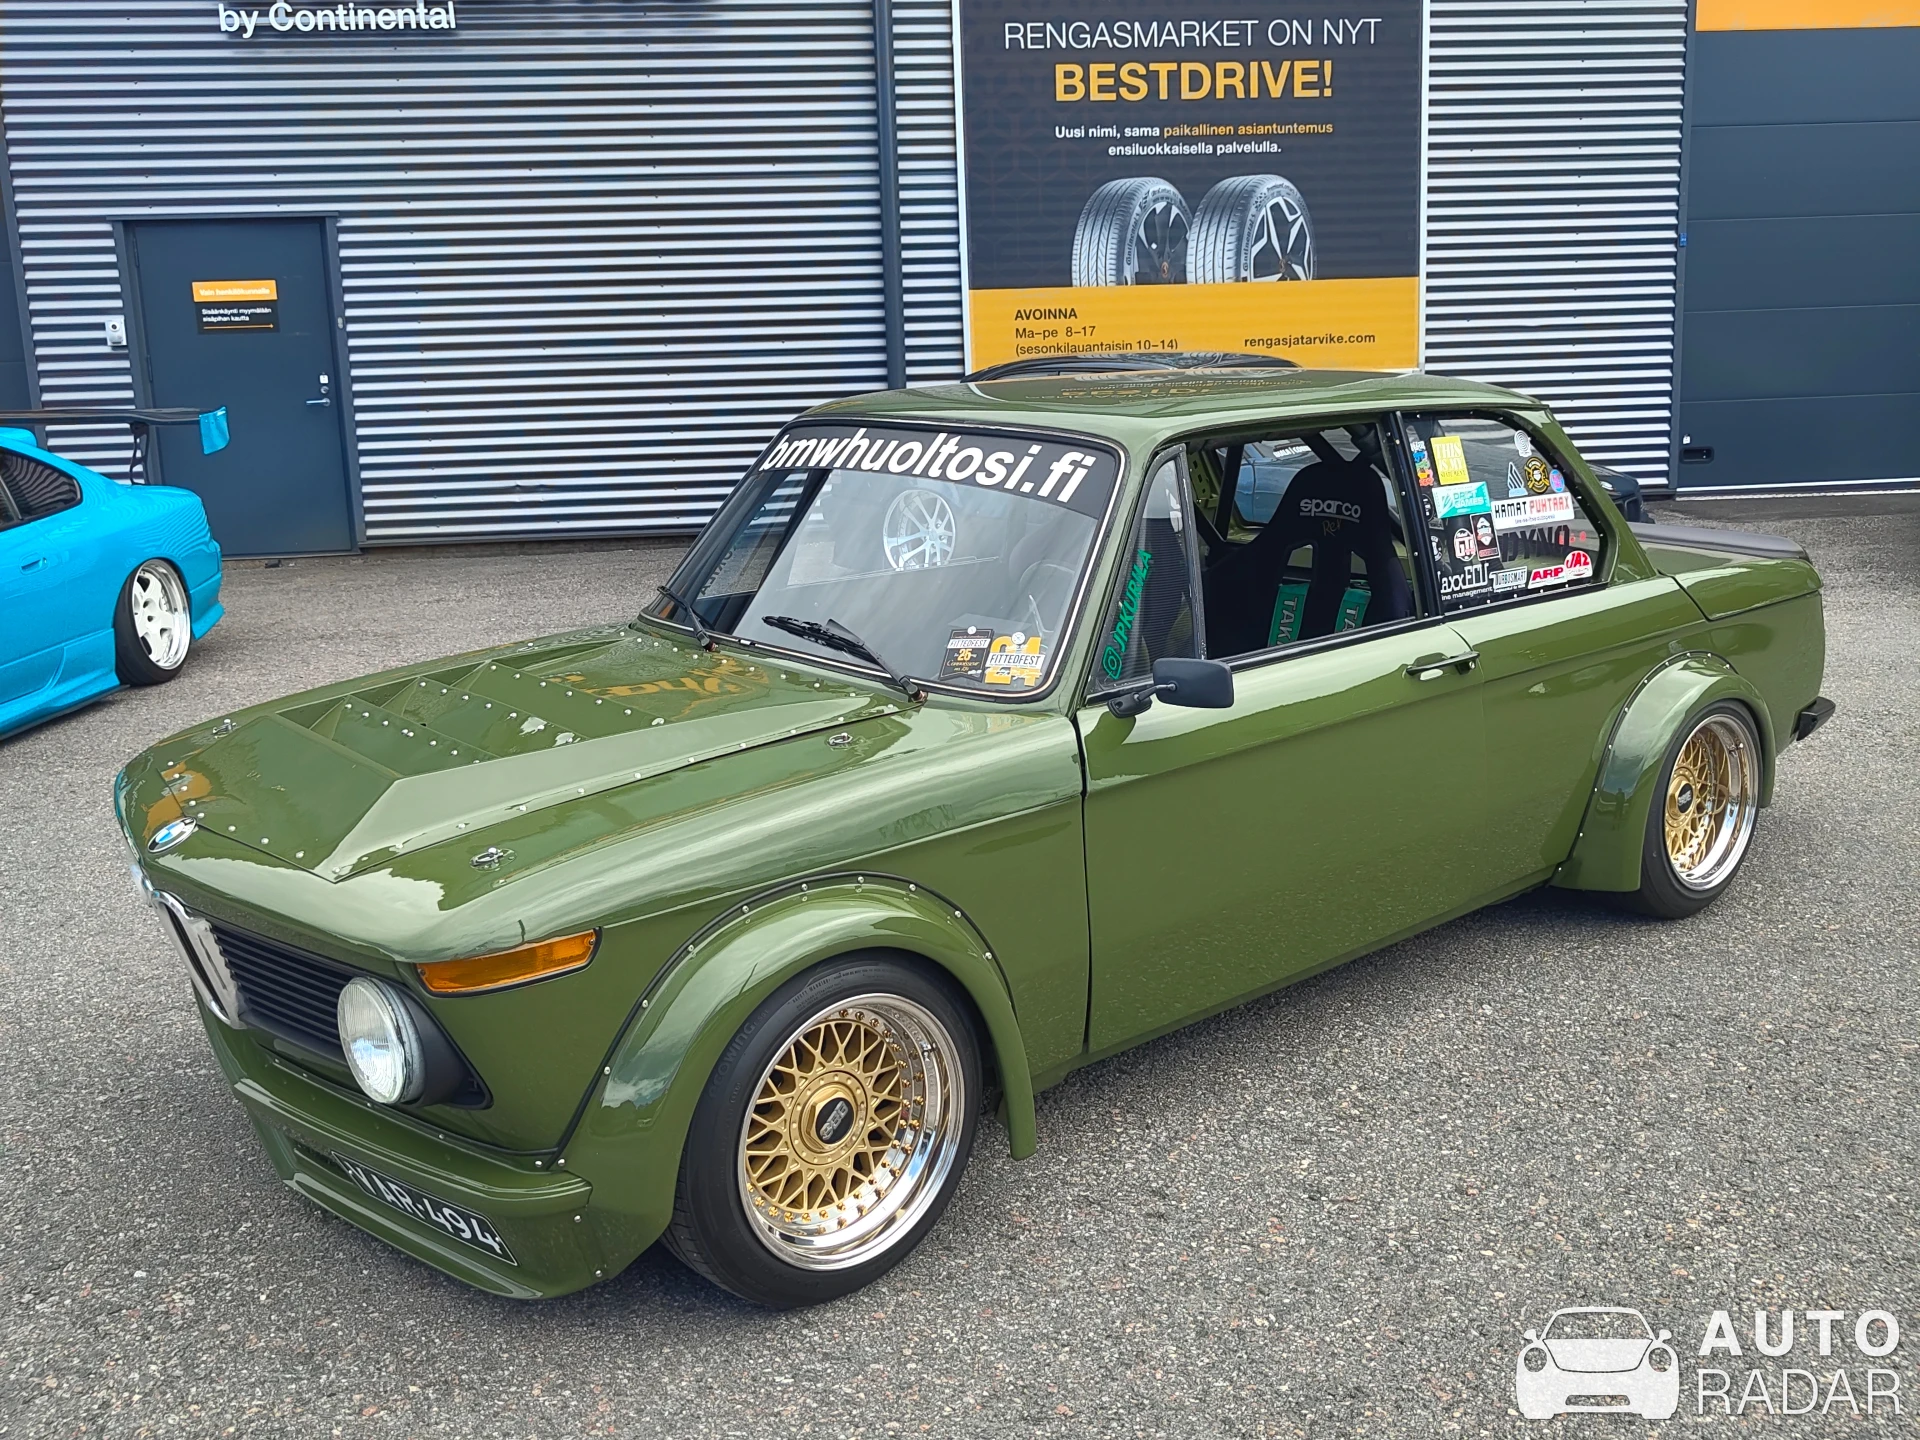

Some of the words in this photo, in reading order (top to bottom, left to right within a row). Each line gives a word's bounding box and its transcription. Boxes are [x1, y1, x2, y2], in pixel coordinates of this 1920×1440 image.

[218, 4, 259, 38] by
[268, 1, 456, 32] Continental
[1004, 20, 1259, 49] RENGASMARKET
[1267, 19, 1312, 46] ON
[1323, 19, 1382, 45] NYT
[1055, 60, 1333, 101] BESTDRIVE!
[1055, 126, 1085, 138] Uusi
[1088, 125, 1120, 139] nimi,
[1124, 127, 1160, 137] sama
[1163, 125, 1234, 139] paikallinen
[1237, 123, 1334, 135] asiantuntemus
[1108, 142, 1213, 156] ensiluokkaisella
[1216, 141, 1282, 156] palvelulla.
[1014, 308, 1078, 321] AVOINNA
[1244, 333, 1376, 348] rengasjatarvike.com
[1016, 341, 1133, 357] (sesonkilauantaisin
[1434, 443, 1462, 459] THIS
[758, 427, 1096, 503] bmwhuoltosi.fi
[1439, 459, 1449, 471] IS
[1449, 458, 1464, 470] MY
[1453, 490, 1476, 499] DRIFT
[1454, 497, 1484, 508] GAMES
[1300, 499, 1361, 517] sparco
[1437, 563, 1489, 593] axxECU
[1531, 567, 1564, 582] ARP
[1452, 586, 1493, 599] management
[1113, 549, 1152, 653] JPKURILA
[1276, 597, 1298, 645] TAK
[949, 639, 988, 648] FITTEDFEST
[990, 654, 1041, 666] FITTEDFEST
[345, 1162, 502, 1254] VAR-494
